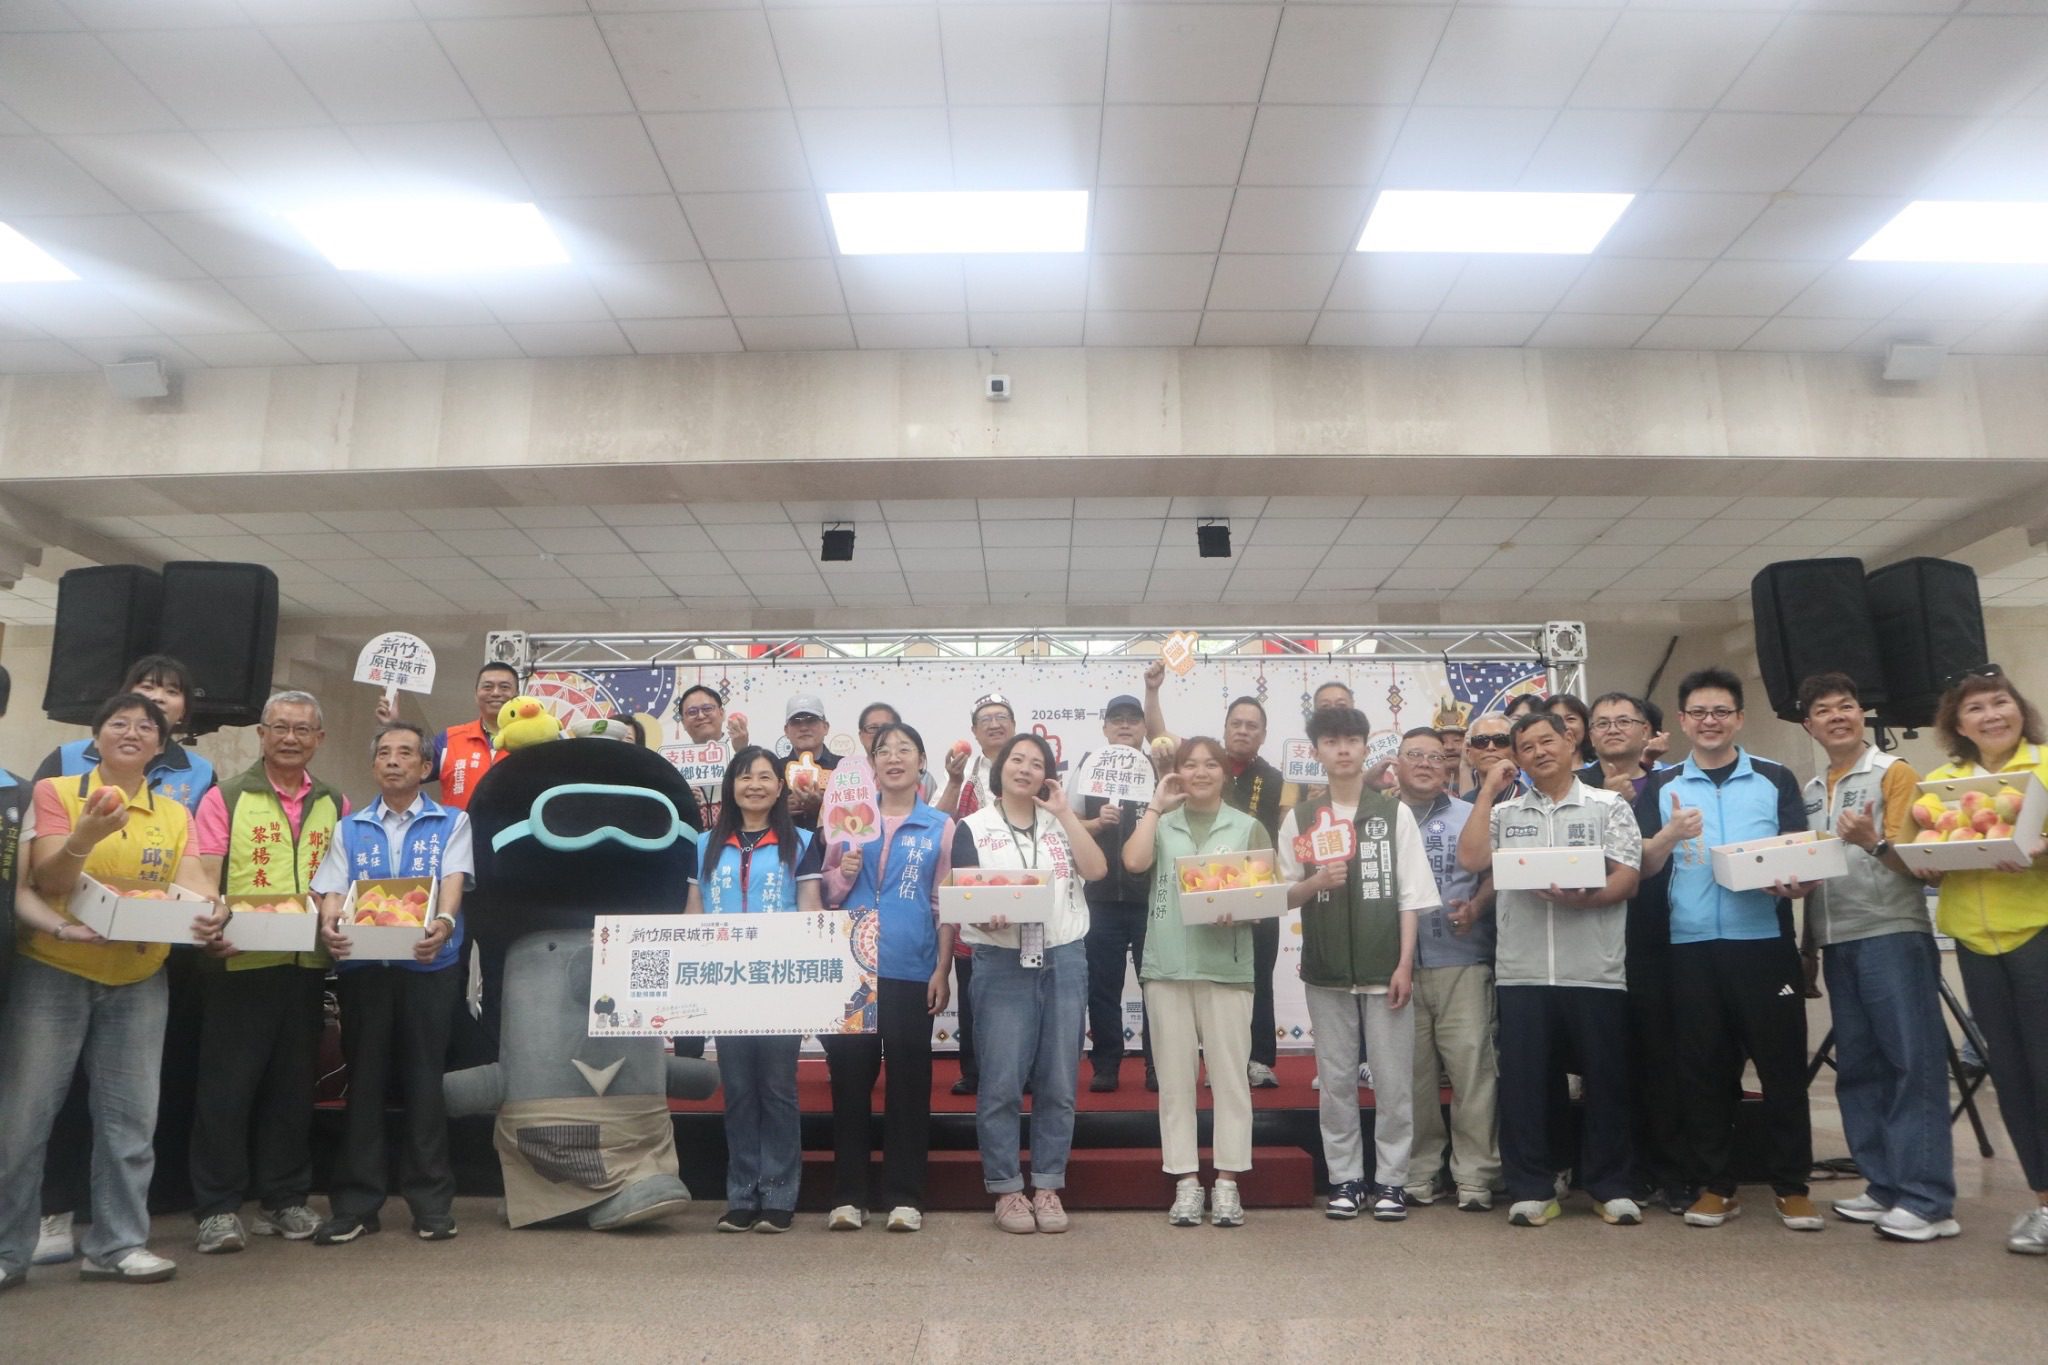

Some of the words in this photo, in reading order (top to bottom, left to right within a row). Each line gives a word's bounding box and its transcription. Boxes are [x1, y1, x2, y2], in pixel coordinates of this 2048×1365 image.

[371, 637, 420, 659] 新竹
[369, 654, 428, 676] 原民城市
[368, 668, 409, 685] 嘉年華
[666, 749, 696, 764] 支持
[1091, 750, 1137, 770] 新竹
[836, 771, 861, 787] 尖石
[1090, 768, 1147, 785] 原民城市
[831, 786, 870, 804] 水蜜桃
[1091, 782, 1130, 796] 嘉年華
[271, 821, 281, 843] 助理
[251, 826, 272, 888] 黎楊森
[371, 844, 381, 867] 主任
[412, 840, 428, 879] 林恩
[899, 848, 923, 900] 林禹佑
[1360, 841, 1381, 900] 歐陽霆
[628, 927, 758, 944] 新竹原民城市嘉年華
[675, 958, 845, 986] 原鄉水蜜桃預購
